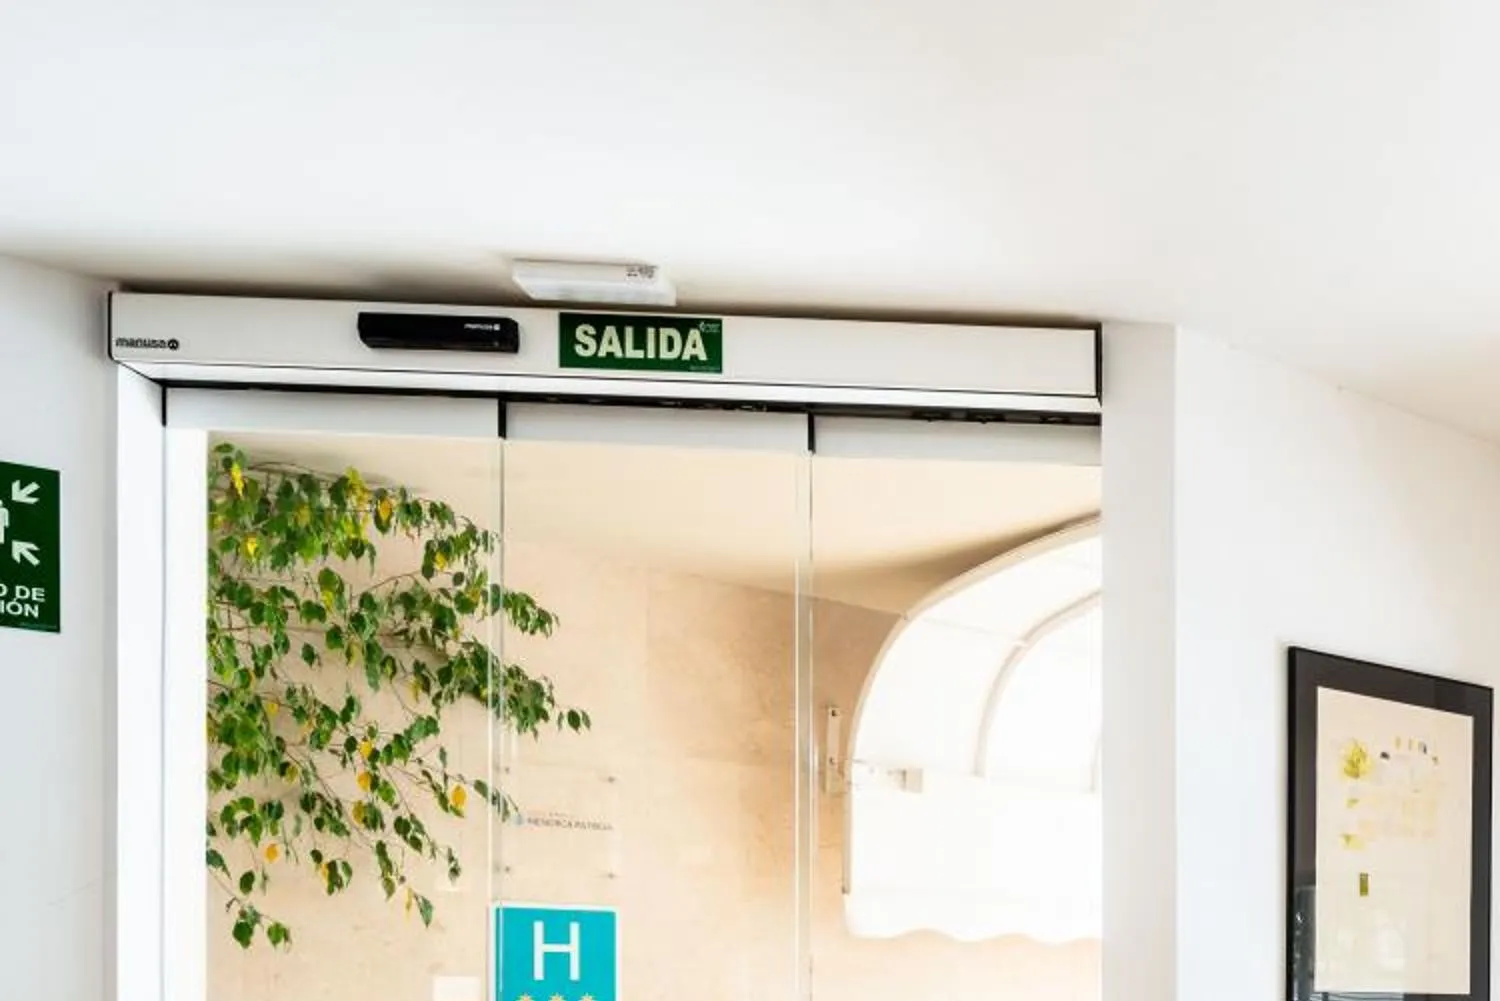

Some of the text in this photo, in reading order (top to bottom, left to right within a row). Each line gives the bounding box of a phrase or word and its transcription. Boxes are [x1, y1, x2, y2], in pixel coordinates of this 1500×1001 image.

[574, 323, 707, 361] SALIDA
[15, 585, 45, 602] DE
[533, 920, 580, 981] H
